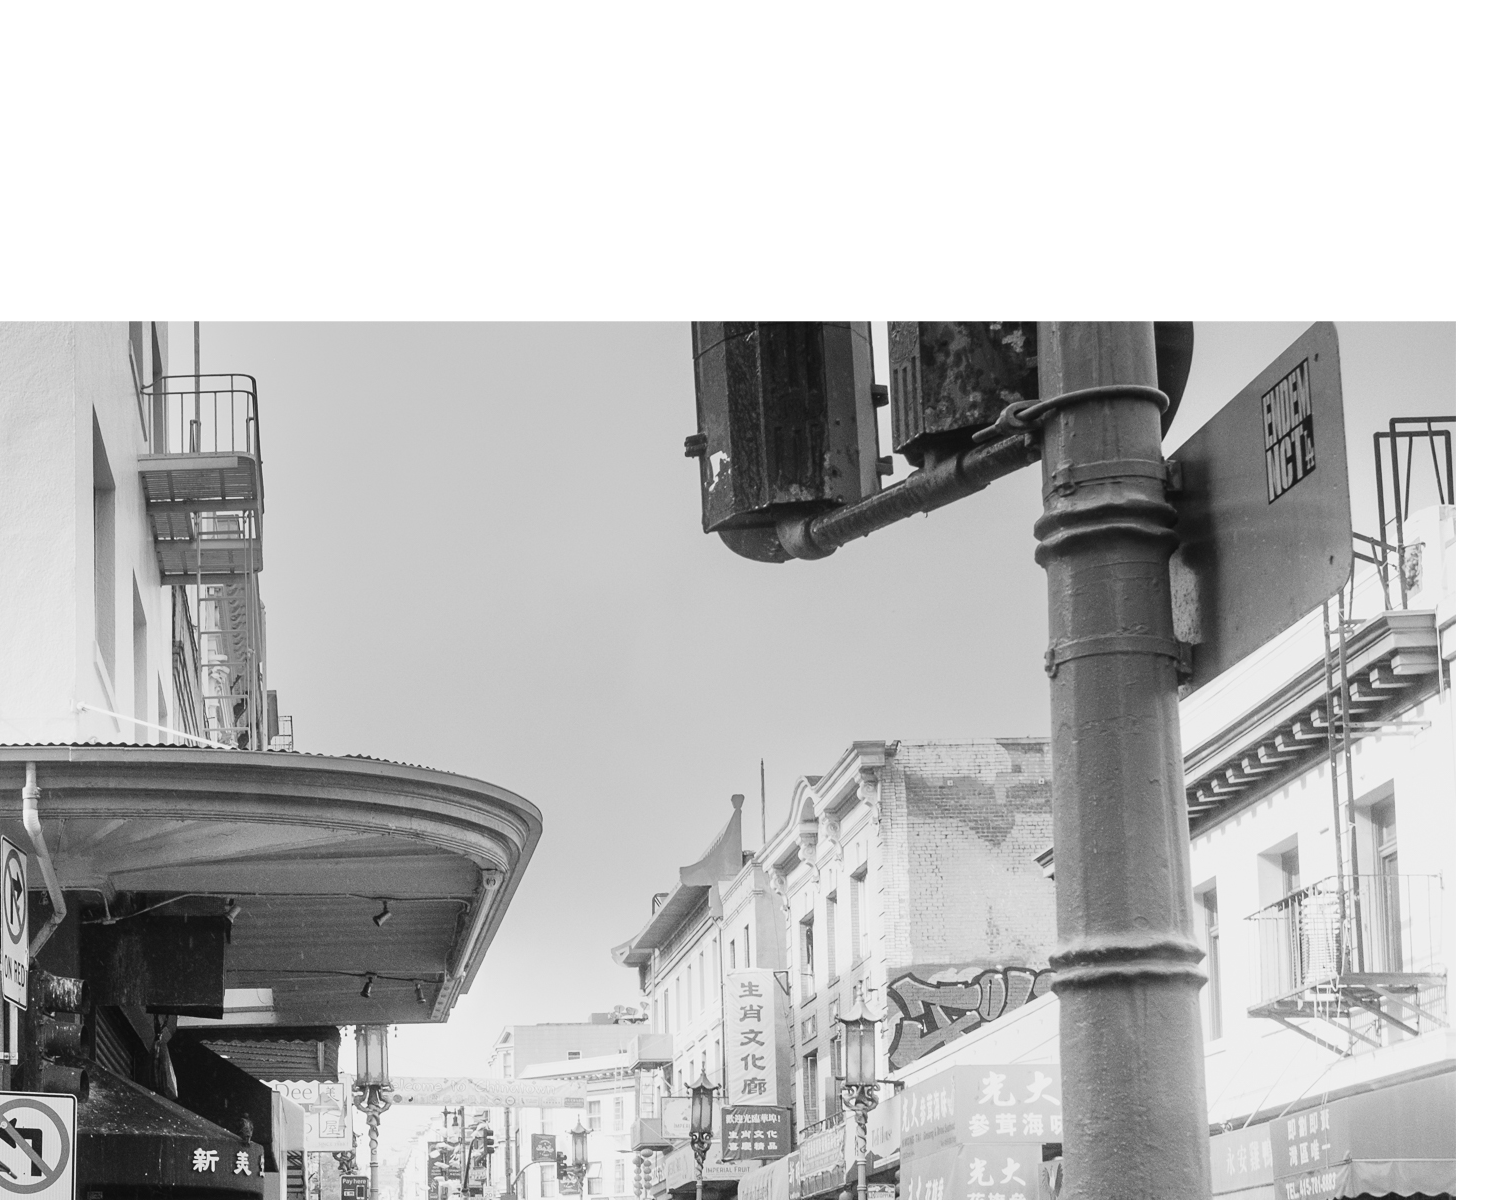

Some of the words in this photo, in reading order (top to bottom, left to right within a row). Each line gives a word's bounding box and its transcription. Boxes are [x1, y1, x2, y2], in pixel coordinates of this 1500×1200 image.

[1262, 360, 1311, 450] ENDEM
[1266, 424, 1304, 502] NCT
[3, 954, 14, 981] ON
[14, 960, 26, 988] RED
[738, 981, 767, 1096] 生肖文化廊
[391, 1079, 442, 1093] elcome
[451, 1080, 467, 1092] to
[475, 1080, 556, 1095] Chinatown
[978, 1070, 1062, 1107] 光大
[192, 1147, 265, 1178] 新美
[705, 1166, 733, 1174] IMPERIAL
[967, 1157, 1027, 1187] 光大
[342, 1178, 353, 1186] Pay
